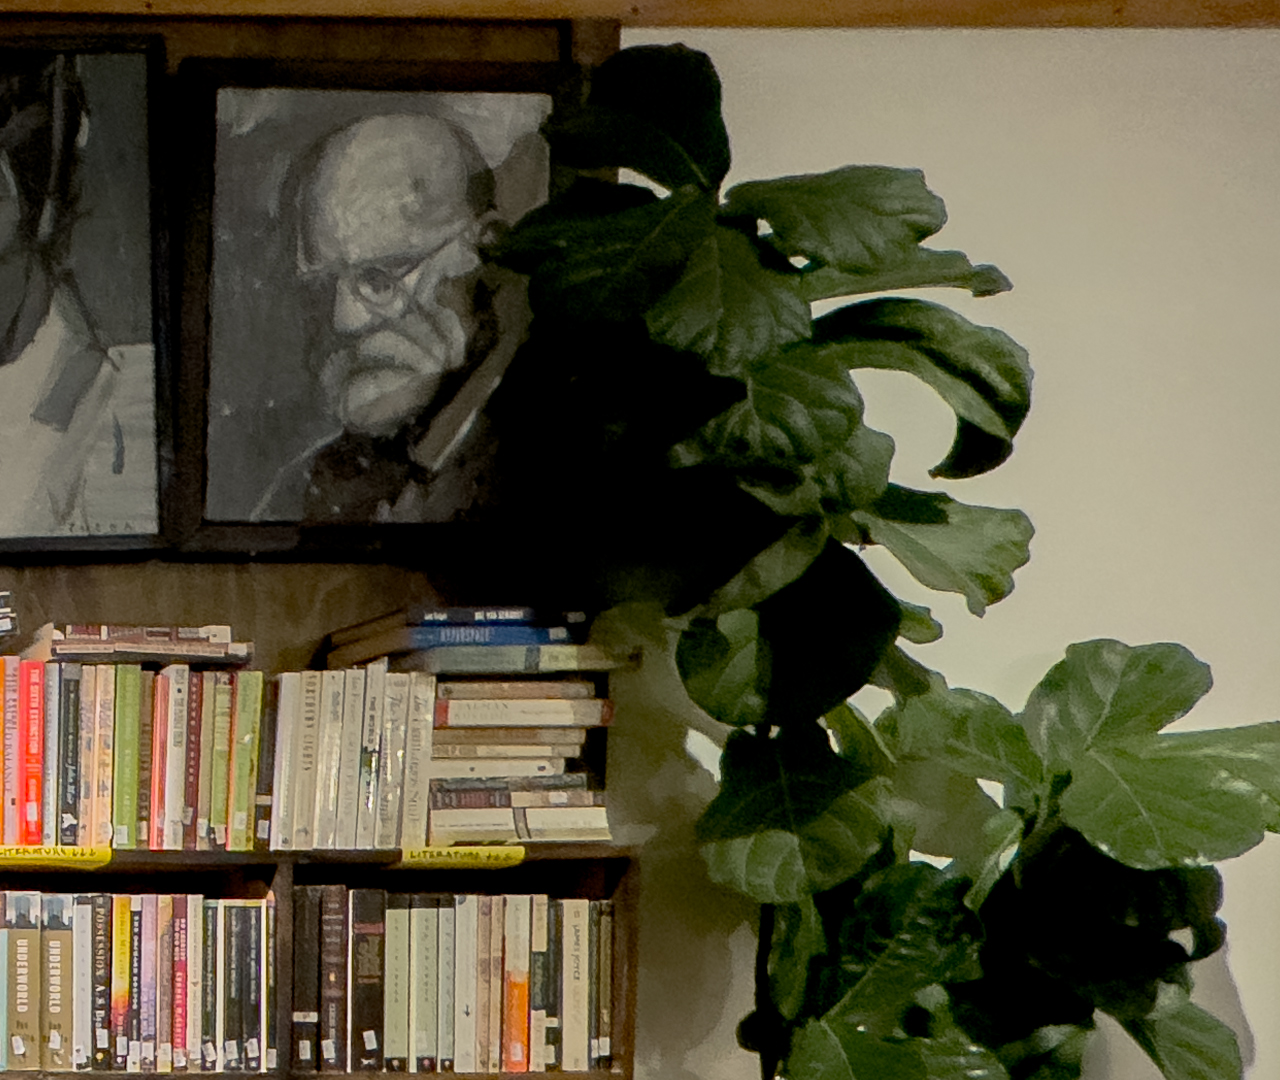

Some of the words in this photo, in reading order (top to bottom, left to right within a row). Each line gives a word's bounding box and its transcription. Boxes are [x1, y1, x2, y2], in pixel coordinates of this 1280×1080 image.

[15, 938, 29, 1012] UNDERWORLD
[48, 939, 62, 1013] UNDERWORLD
[94, 907, 106, 976] POSSESSION
